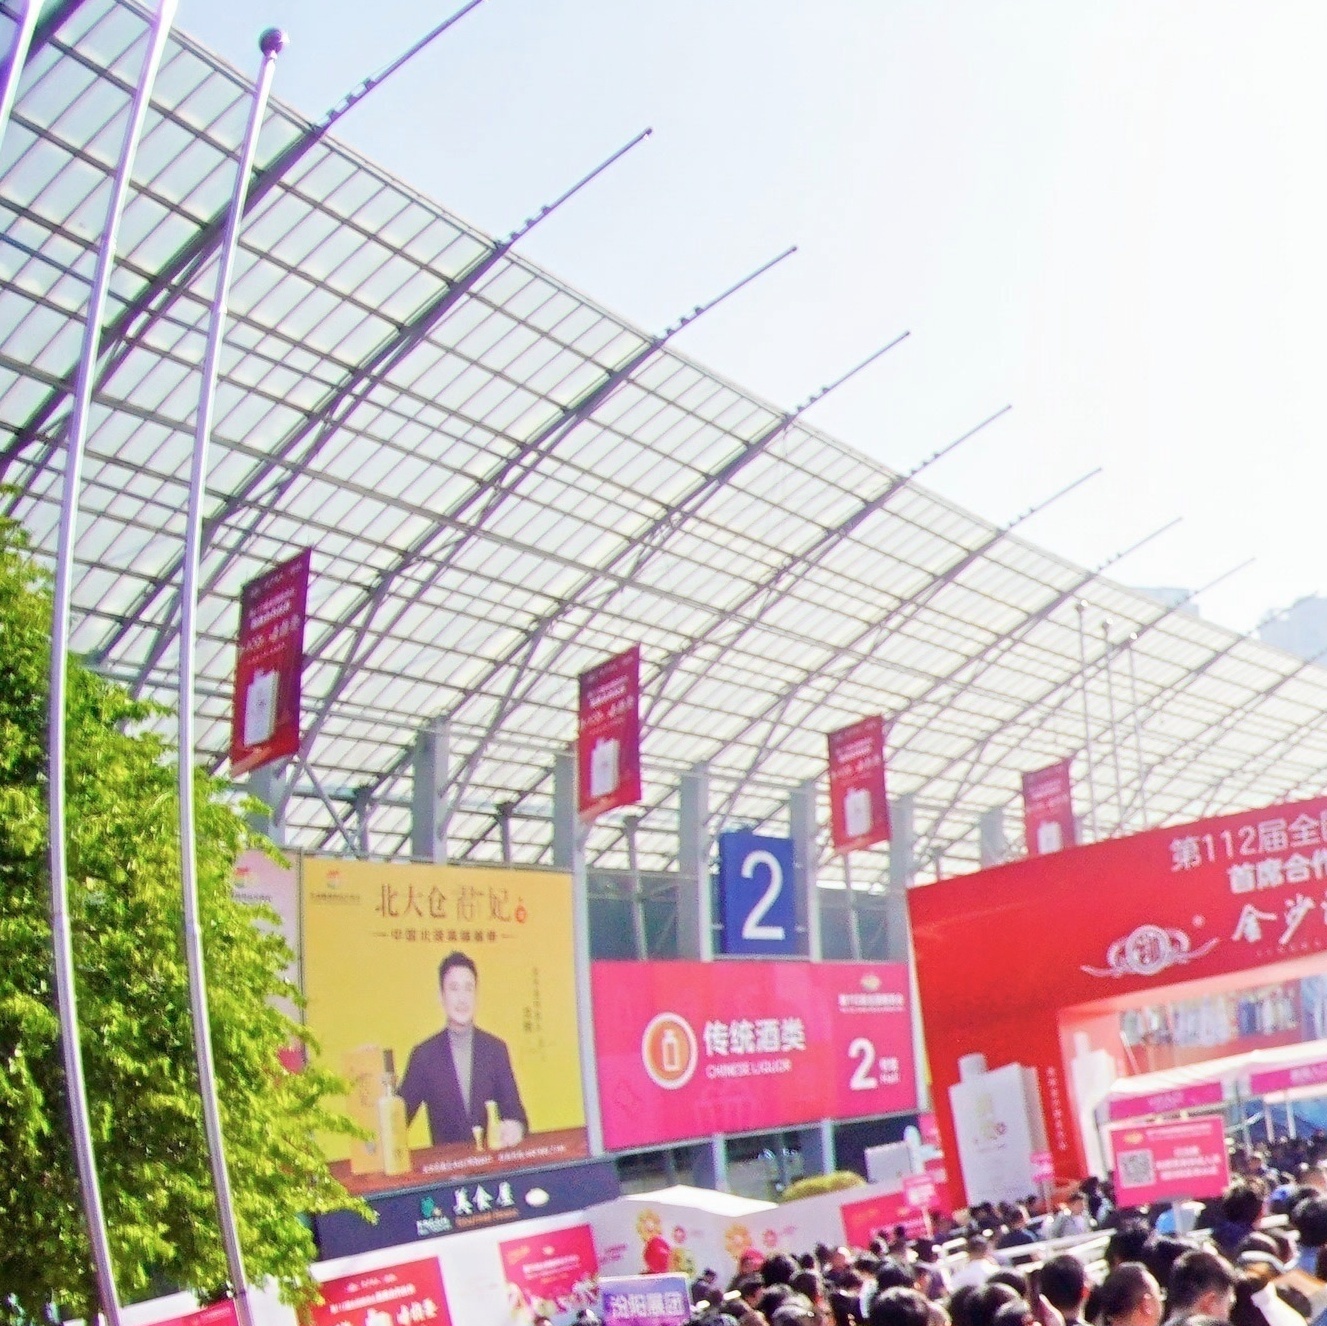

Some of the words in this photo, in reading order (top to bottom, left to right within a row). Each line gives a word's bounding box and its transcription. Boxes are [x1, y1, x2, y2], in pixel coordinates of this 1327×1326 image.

[741, 849, 785, 940] 2
[703, 1016, 806, 1057] 传统酒类
[848, 1037, 879, 1090] 2
